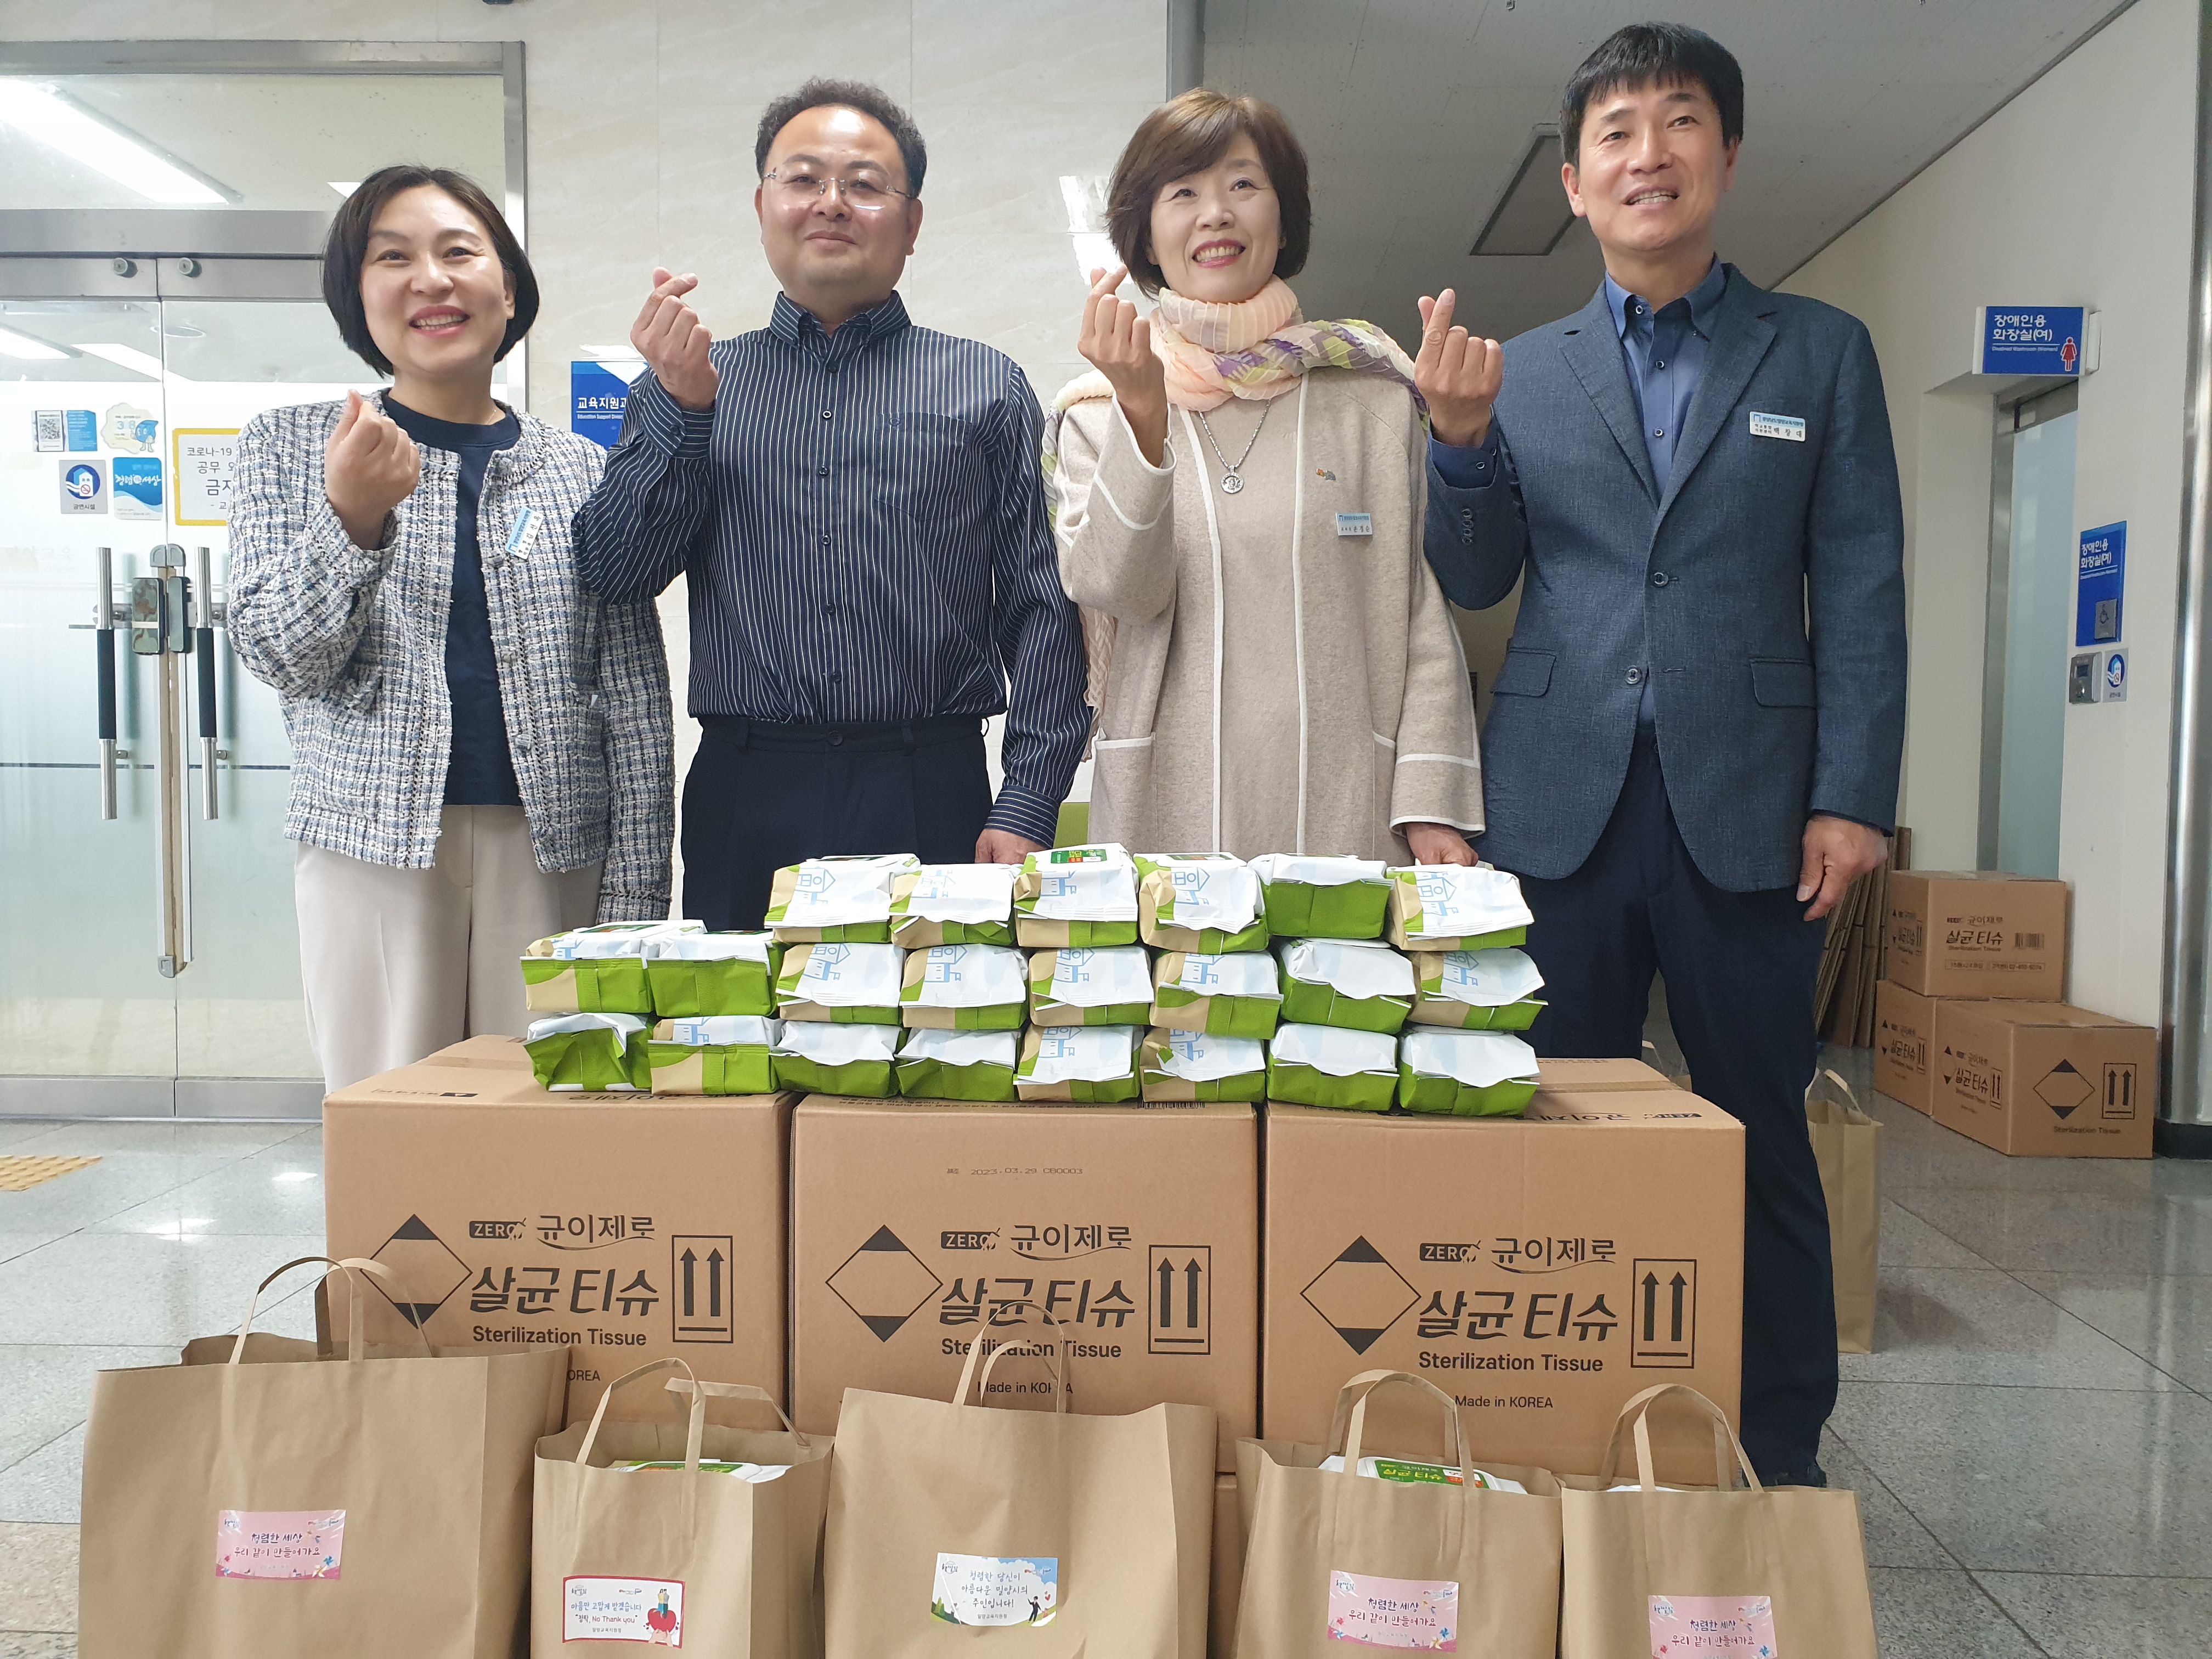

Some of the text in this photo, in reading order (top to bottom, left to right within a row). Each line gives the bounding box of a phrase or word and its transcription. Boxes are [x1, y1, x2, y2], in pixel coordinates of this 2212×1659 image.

[1994, 314, 2047, 328] 장애인용
[1993, 329, 2053, 342] 화장실(여)
[187, 447, 233, 456] 코로나-19
[197, 461, 221, 474] 공무
[2081, 538, 2109, 556] 장애인용
[2080, 551, 2112, 568] 화장실(여)
[1945, 930, 2004, 945] 살균 티슈
[1955, 1068, 1989, 1094] 살균 티슈
[469, 1266, 659, 1317] 살균 티슈
[939, 1278, 1135, 1328] 살균 티슈
[1417, 1290, 1618, 1342] 살균 티슈
[473, 1325, 647, 1346] Sterilization Tissue
[1419, 1351, 1603, 1372] Sterilization Tissue
[1016, 1383, 1026, 1393] in
[1455, 1395, 1553, 1408] Made in KOREA
[251, 1532, 303, 1544] 청렴한 세상
[234, 1546, 321, 1558] 우리 같이 만들어가요
[969, 1570, 1020, 1582] 청렴한 당신이
[961, 1583, 1028, 1595] 아름다운 밀양시의
[571, 1601, 642, 1612] 마음만 고맙게 받겠습니다
[972, 1599, 1014, 1609] 주인입니다!
[1368, 1597, 1419, 1612] 청렴한 세상
[1348, 1609, 1437, 1627] 우리 같이 만들어가요
[1690, 1620, 1736, 1632] 청렴한 세상
[1671, 1635, 1756, 1647] 우리 같이 만들어가요
